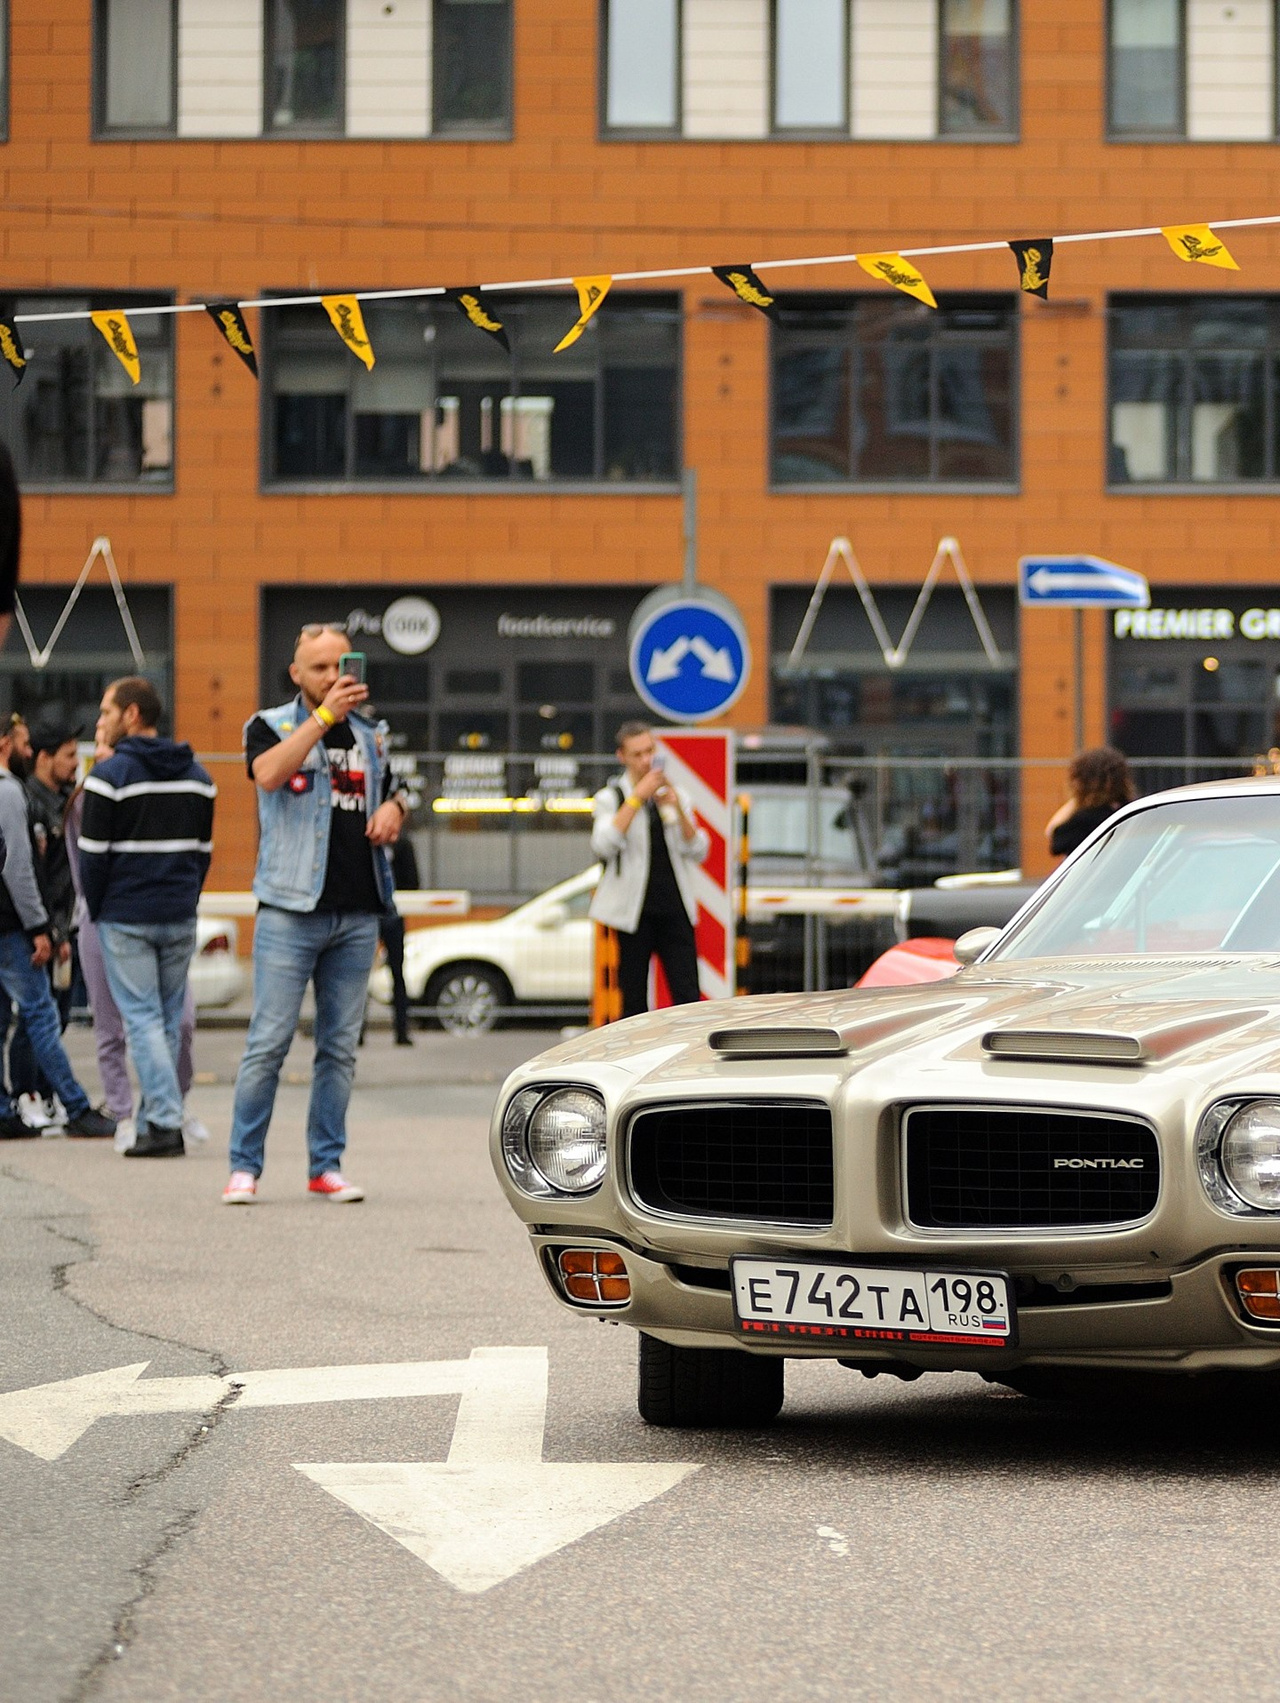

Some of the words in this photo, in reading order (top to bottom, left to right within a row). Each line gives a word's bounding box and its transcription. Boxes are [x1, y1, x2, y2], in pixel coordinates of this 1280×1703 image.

[1114, 608, 1235, 640] PREMIER
[1053, 1158, 1144, 1169] PONTIAC
[930, 1277, 997, 1315] 198
[948, 1313, 981, 1328] RUS
